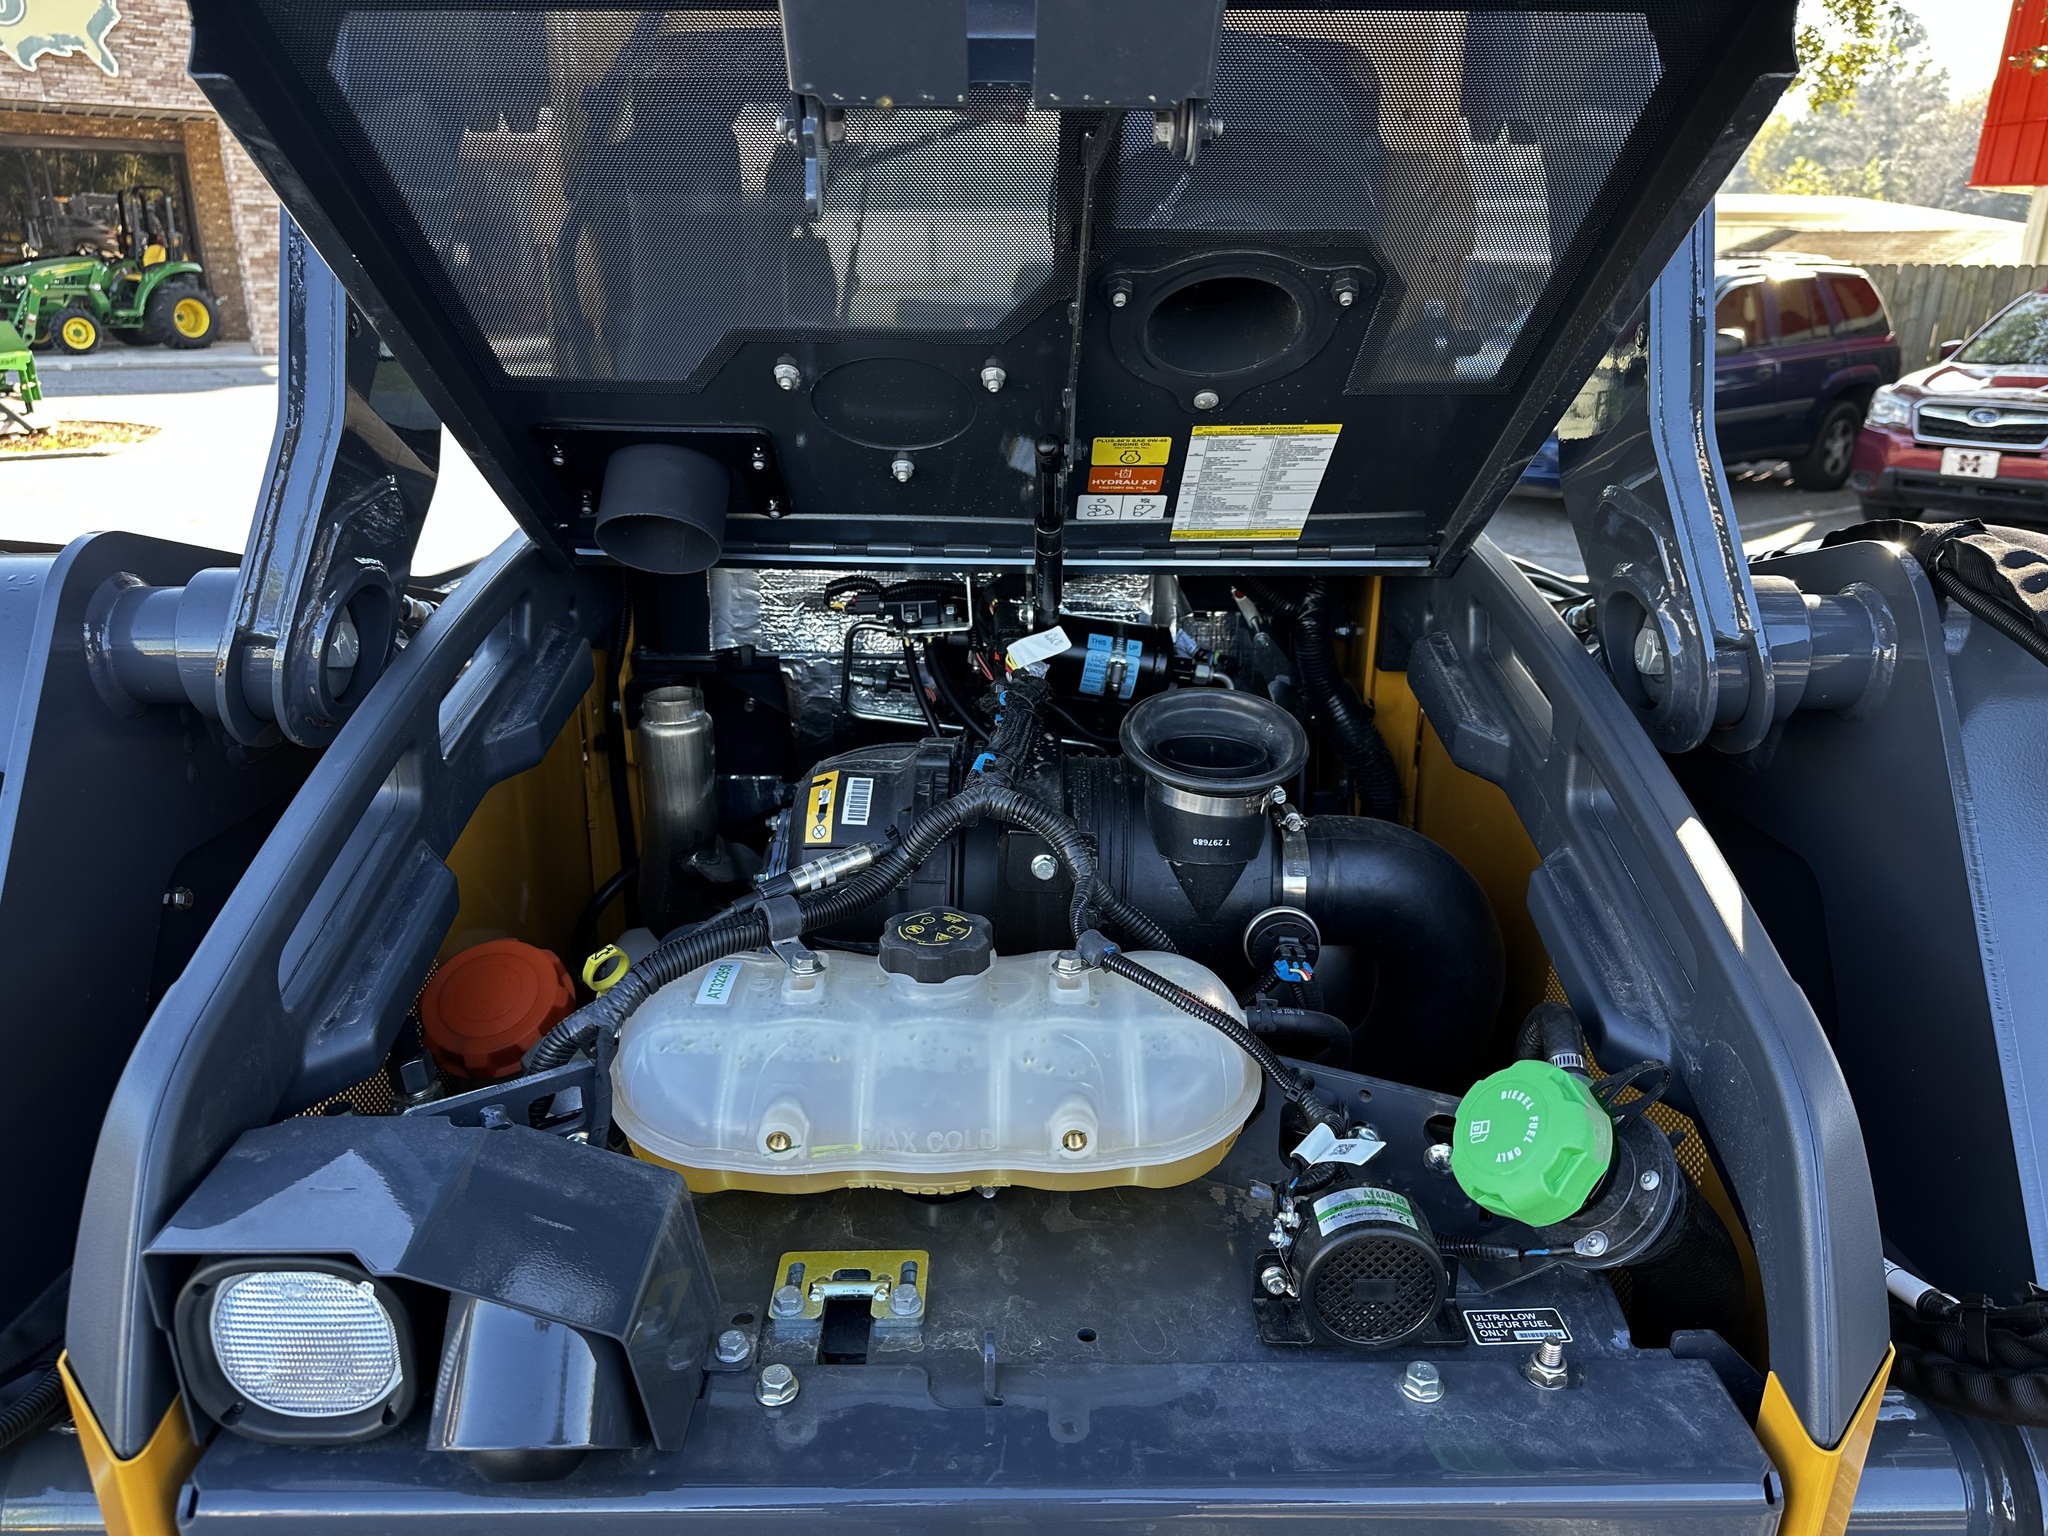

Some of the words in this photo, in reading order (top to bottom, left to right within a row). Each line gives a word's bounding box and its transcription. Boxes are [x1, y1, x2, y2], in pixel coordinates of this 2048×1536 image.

[1091, 638, 1107, 646] THIS
[1192, 838, 1223, 846] 297689
[706, 964, 734, 999] AT322958
[1501, 1089, 1534, 1111] DIESEL
[1523, 1115, 1539, 1143] FUEL
[863, 1130, 917, 1152] MAX
[926, 1128, 996, 1152] COLD
[1495, 1146, 1522, 1163] ONLY
[1472, 1314, 1509, 1322] ULTRA
[1476, 1321, 1521, 1329] SULFUR
[1522, 1320, 1553, 1328] FUEL
[1479, 1329, 1509, 1337] ONLY
